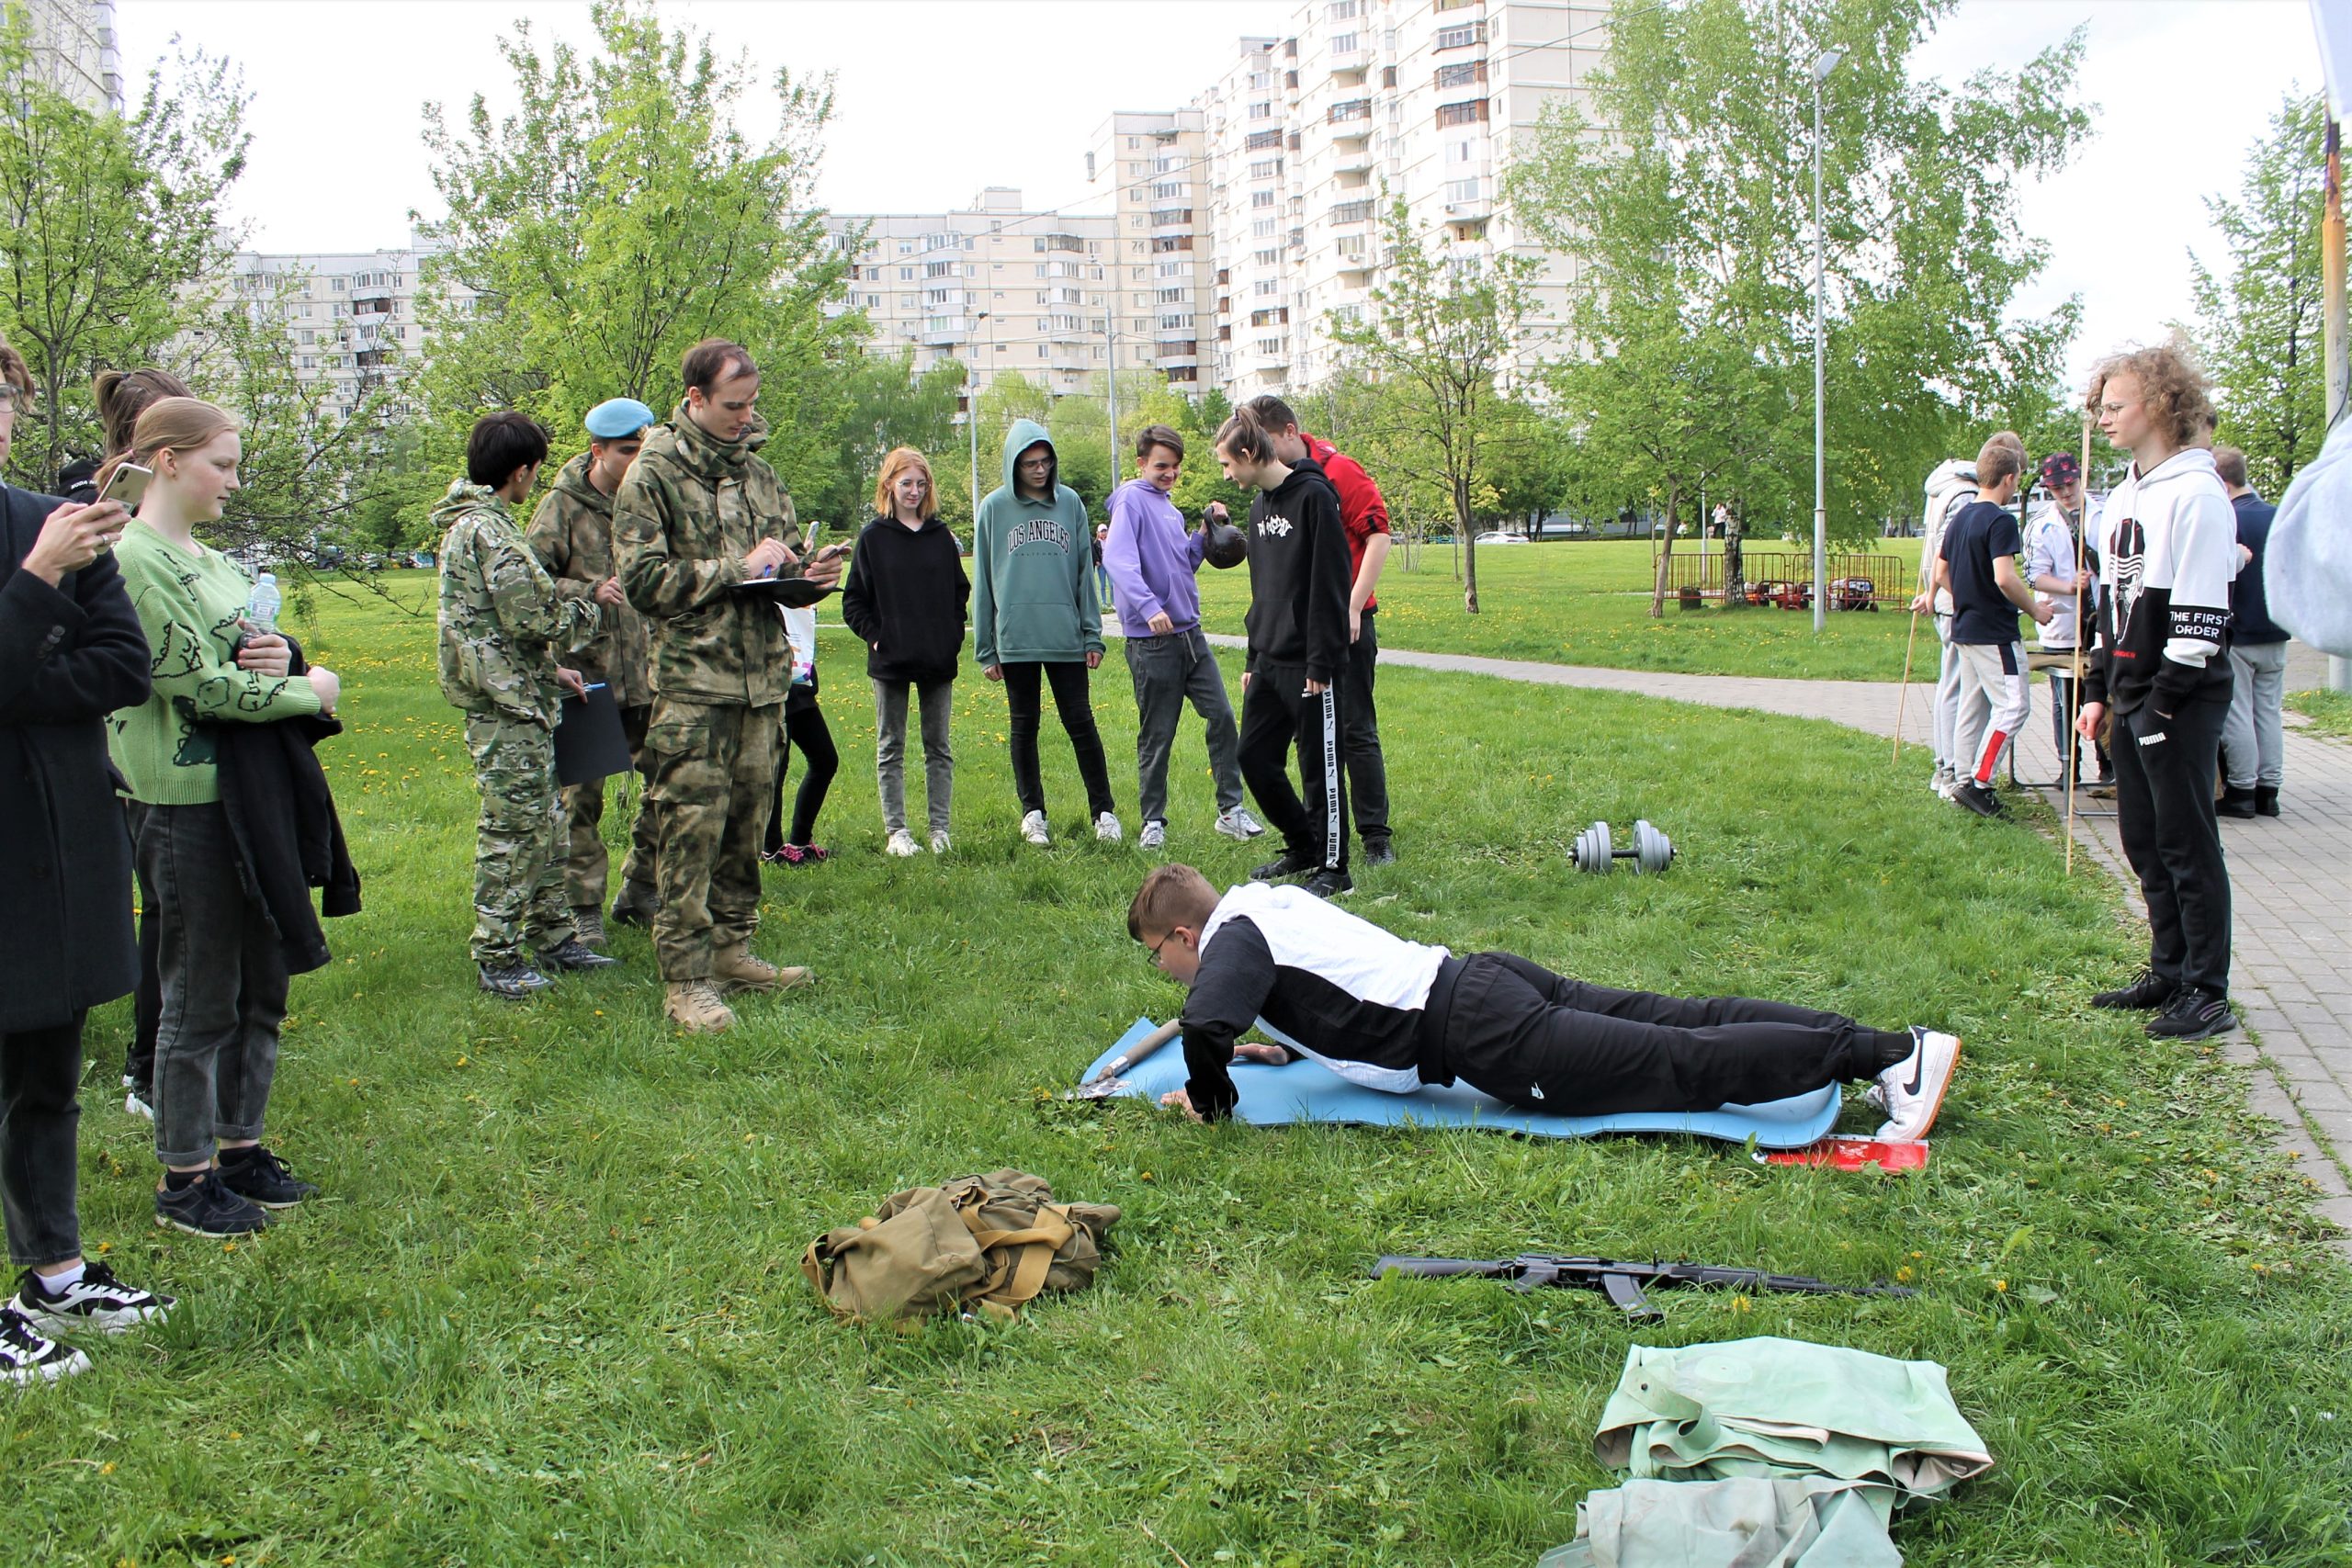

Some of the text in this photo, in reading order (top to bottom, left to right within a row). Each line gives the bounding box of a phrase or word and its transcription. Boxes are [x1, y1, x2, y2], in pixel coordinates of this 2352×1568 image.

[1008, 519, 1070, 555] LOS ANGELES
[2170, 611, 2228, 626] THE FIRST
[2175, 625, 2220, 638] ORDER
[1324, 691, 1333, 719] PUMA
[2138, 732, 2166, 746] PUMA
[1327, 740, 1335, 768] PUMA
[1329, 788, 1338, 814] PUMA
[1329, 832, 1338, 857] PUMA
